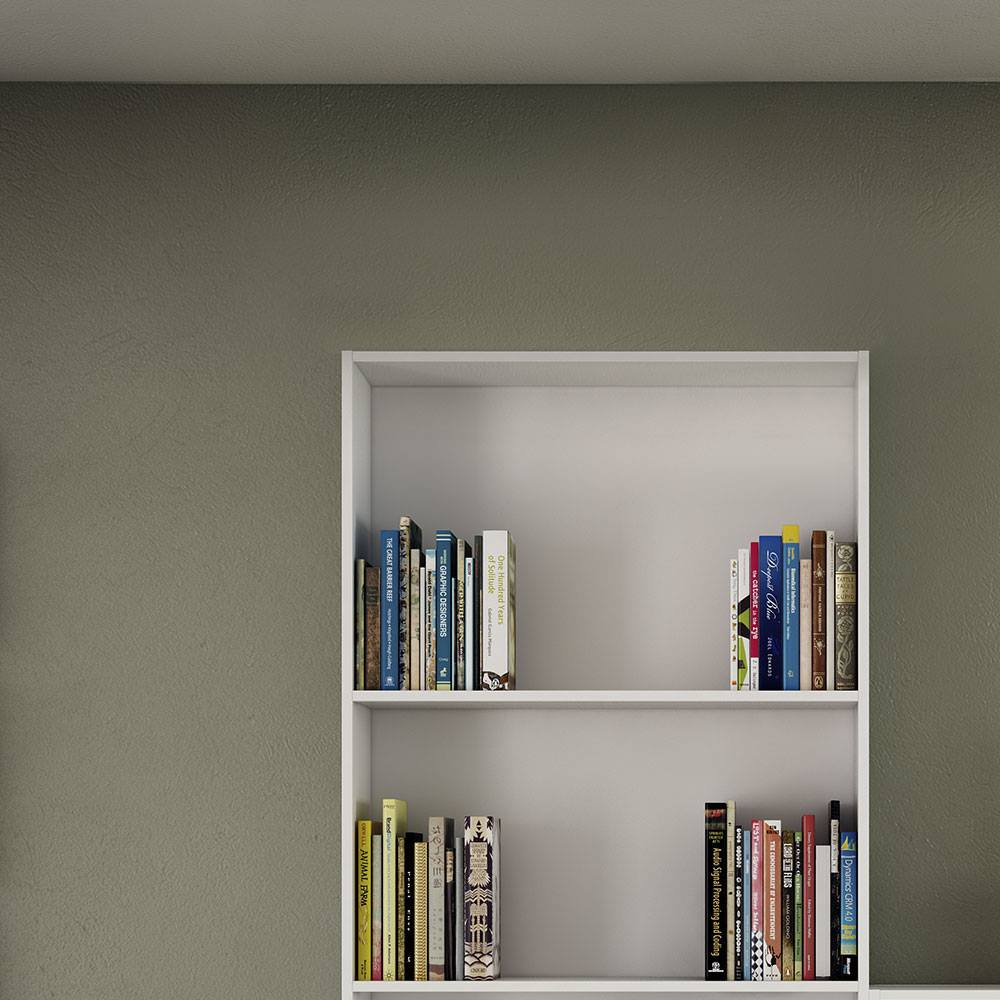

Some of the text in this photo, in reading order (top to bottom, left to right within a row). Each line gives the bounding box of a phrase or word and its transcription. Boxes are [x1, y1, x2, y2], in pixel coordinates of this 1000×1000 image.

[488, 555, 495, 564] of
[761, 550, 780, 621] Deepest Blue
[497, 555, 505, 625] One Hundred Years
[750, 627, 758, 639] rye
[360, 849, 368, 906] ANIMAL FARM
[784, 843, 792, 857] LORD
[711, 848, 722, 956] Audio Signal Processing and Coding
[784, 872, 792, 888] FLIES
[843, 859, 853, 922] Dynamics CRM 4.0
